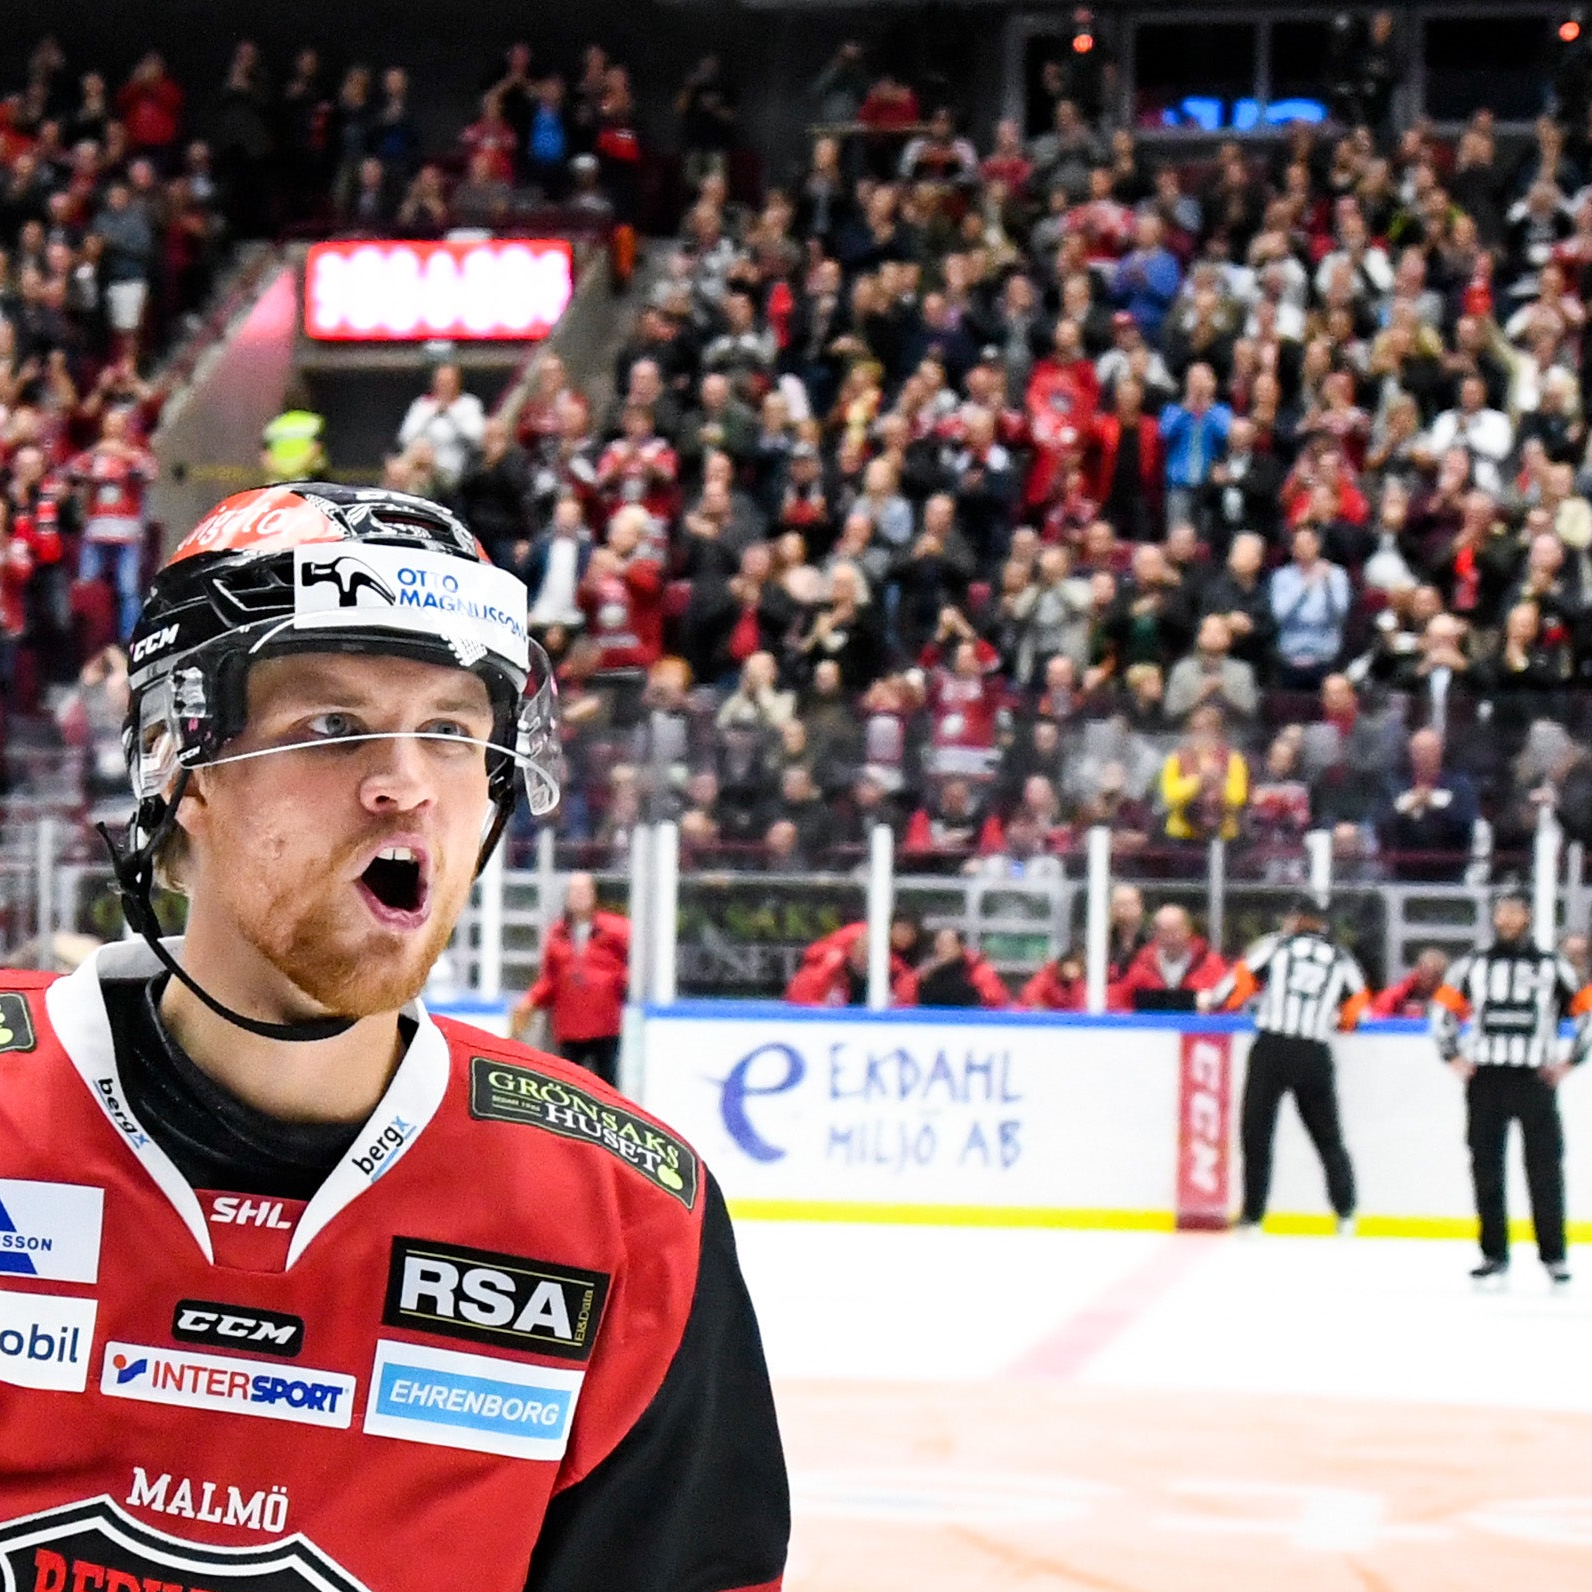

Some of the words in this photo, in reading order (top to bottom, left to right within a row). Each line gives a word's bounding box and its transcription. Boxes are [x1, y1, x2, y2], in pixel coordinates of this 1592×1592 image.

[131, 622, 180, 663] CCM
[828, 1041, 1024, 1104] EKDAHL
[487, 1070, 681, 1170] GRÖNSAKS
[545, 1101, 662, 1174] HUSET
[959, 1119, 1024, 1169] AB
[210, 1196, 293, 1230] SHL
[400, 1256, 573, 1340] RSA
[176, 1308, 298, 1345] CCM
[151, 1360, 345, 1414] INTERSPORT
[389, 1379, 559, 1426] EHRENBORG
[126, 1467, 290, 1534] MALMÖ
